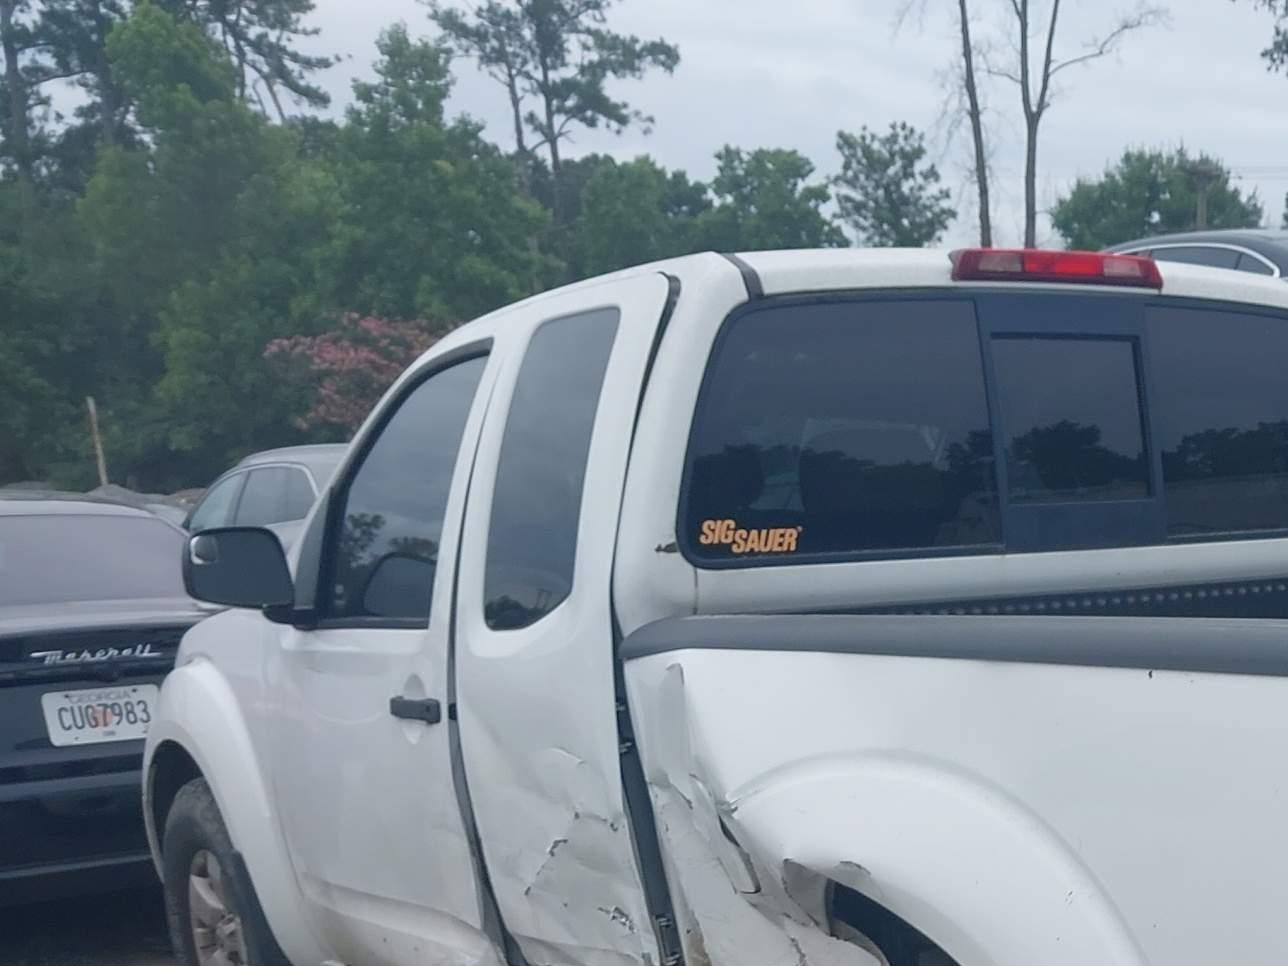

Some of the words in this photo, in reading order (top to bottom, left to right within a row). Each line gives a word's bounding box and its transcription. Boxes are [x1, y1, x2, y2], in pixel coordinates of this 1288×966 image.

[700, 519, 736, 544] SIG
[731, 527, 799, 553] SAUER
[57, 700, 151, 731] CUG7983
